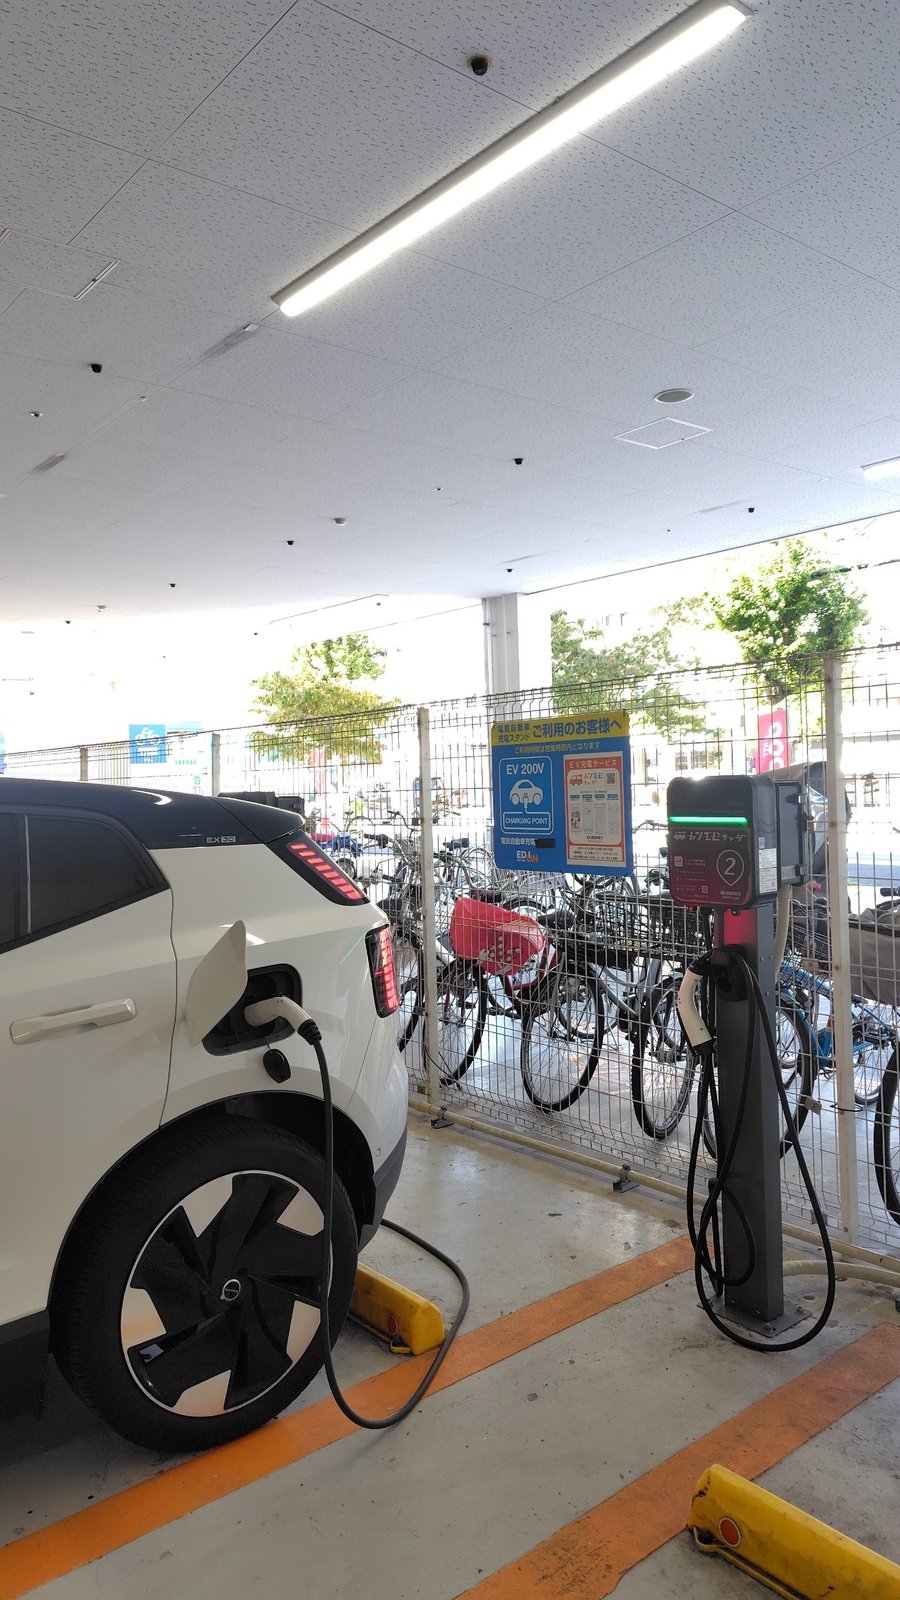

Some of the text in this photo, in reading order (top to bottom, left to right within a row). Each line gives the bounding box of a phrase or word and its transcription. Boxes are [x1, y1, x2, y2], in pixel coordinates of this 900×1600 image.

[497, 717, 622, 738] 電気自動車 ご利用のお客様へ
[497, 733, 531, 743] 充電スタンド
[506, 762, 544, 775] EV 200V
[505, 816, 549, 825] CHARGING POINT
[724, 857, 736, 876] 2
